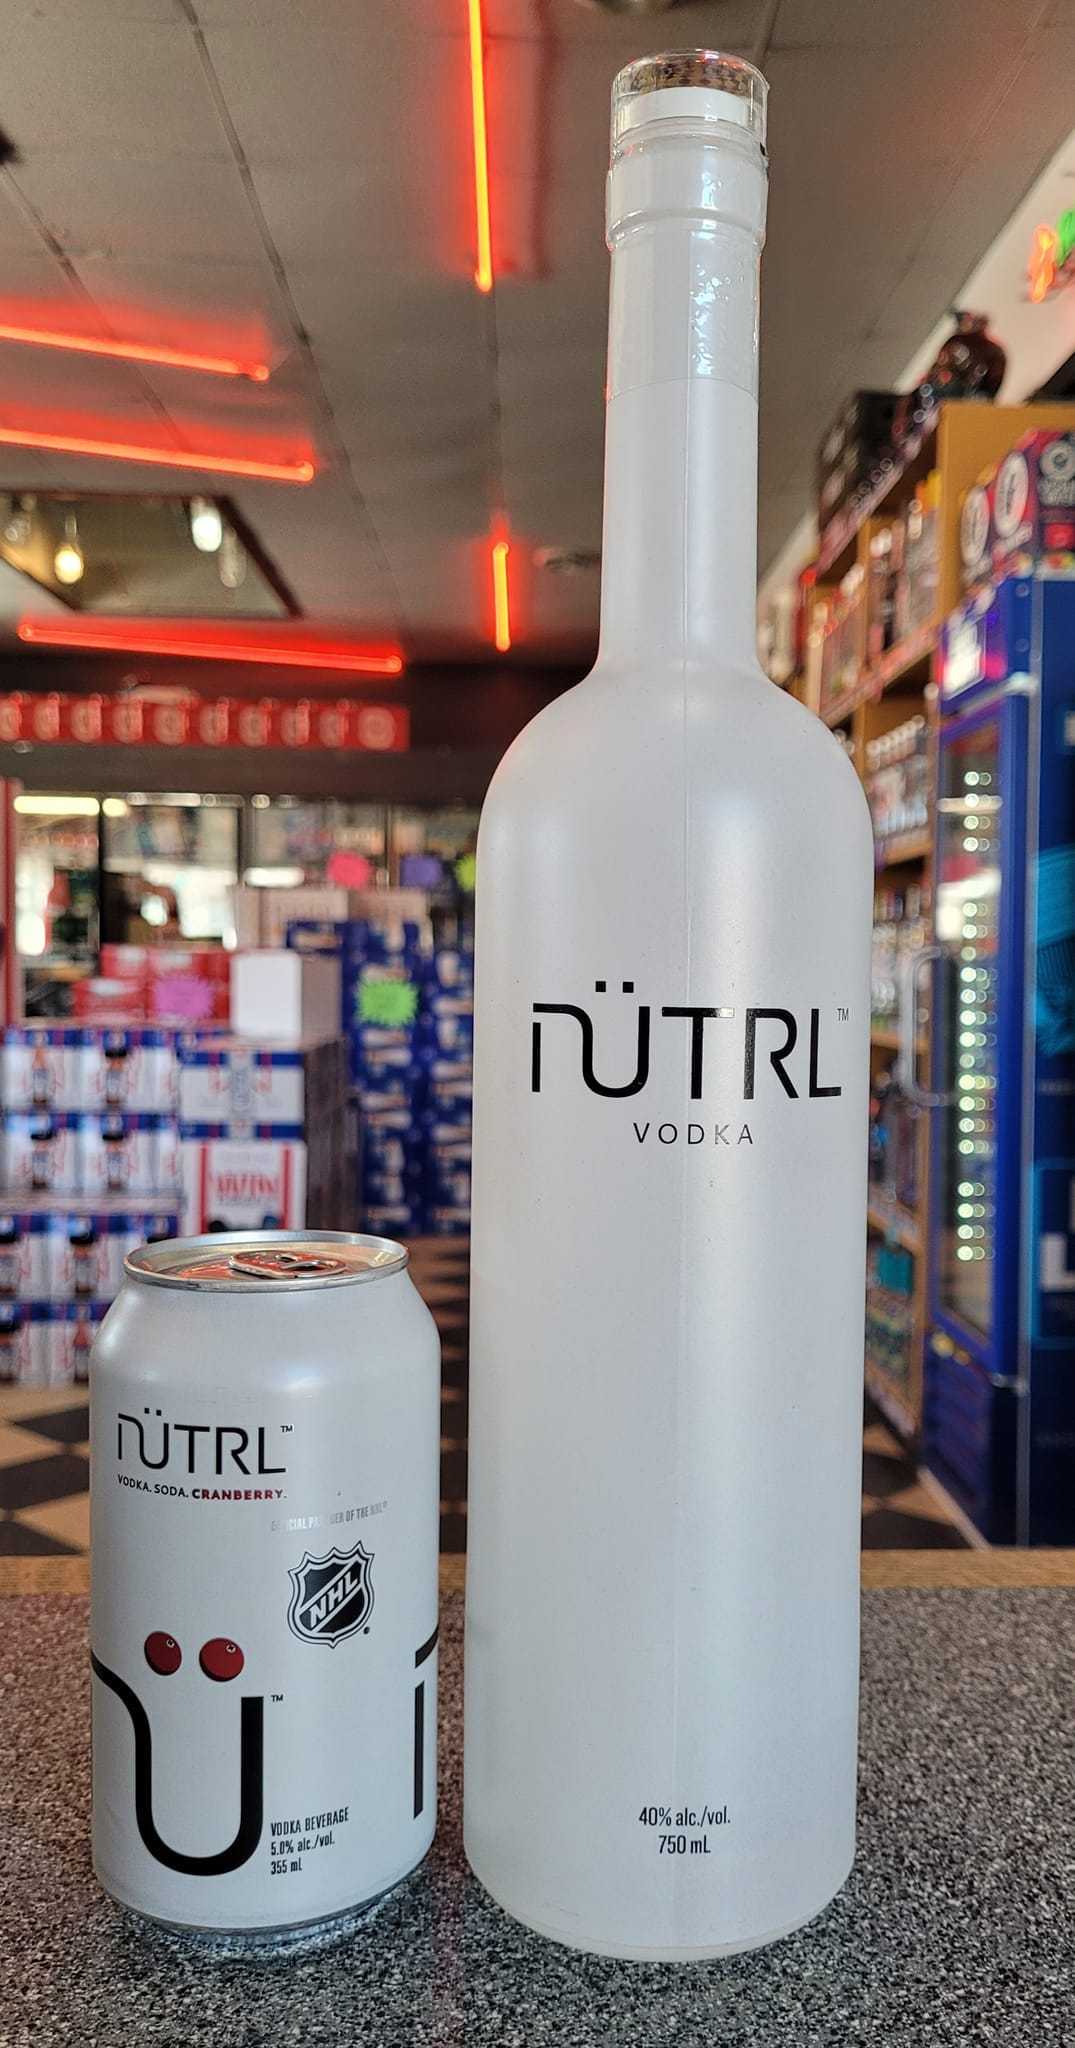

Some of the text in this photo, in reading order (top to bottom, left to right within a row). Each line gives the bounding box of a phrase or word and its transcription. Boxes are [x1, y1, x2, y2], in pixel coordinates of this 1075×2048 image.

[633, 1122, 754, 1146] VODKA
[117, 1473, 288, 1501] VODKA. SODA. CRANBERRY.
[308, 1570, 359, 1629] NHL
[270, 1805, 350, 1837] VODKA BEVERAGE
[638, 1805, 731, 1828] 40% alc./vol.
[270, 1830, 336, 1856] 5.0% alc./vol.
[658, 1834, 711, 1854] 750 mL
[270, 1859, 287, 1875] 355
